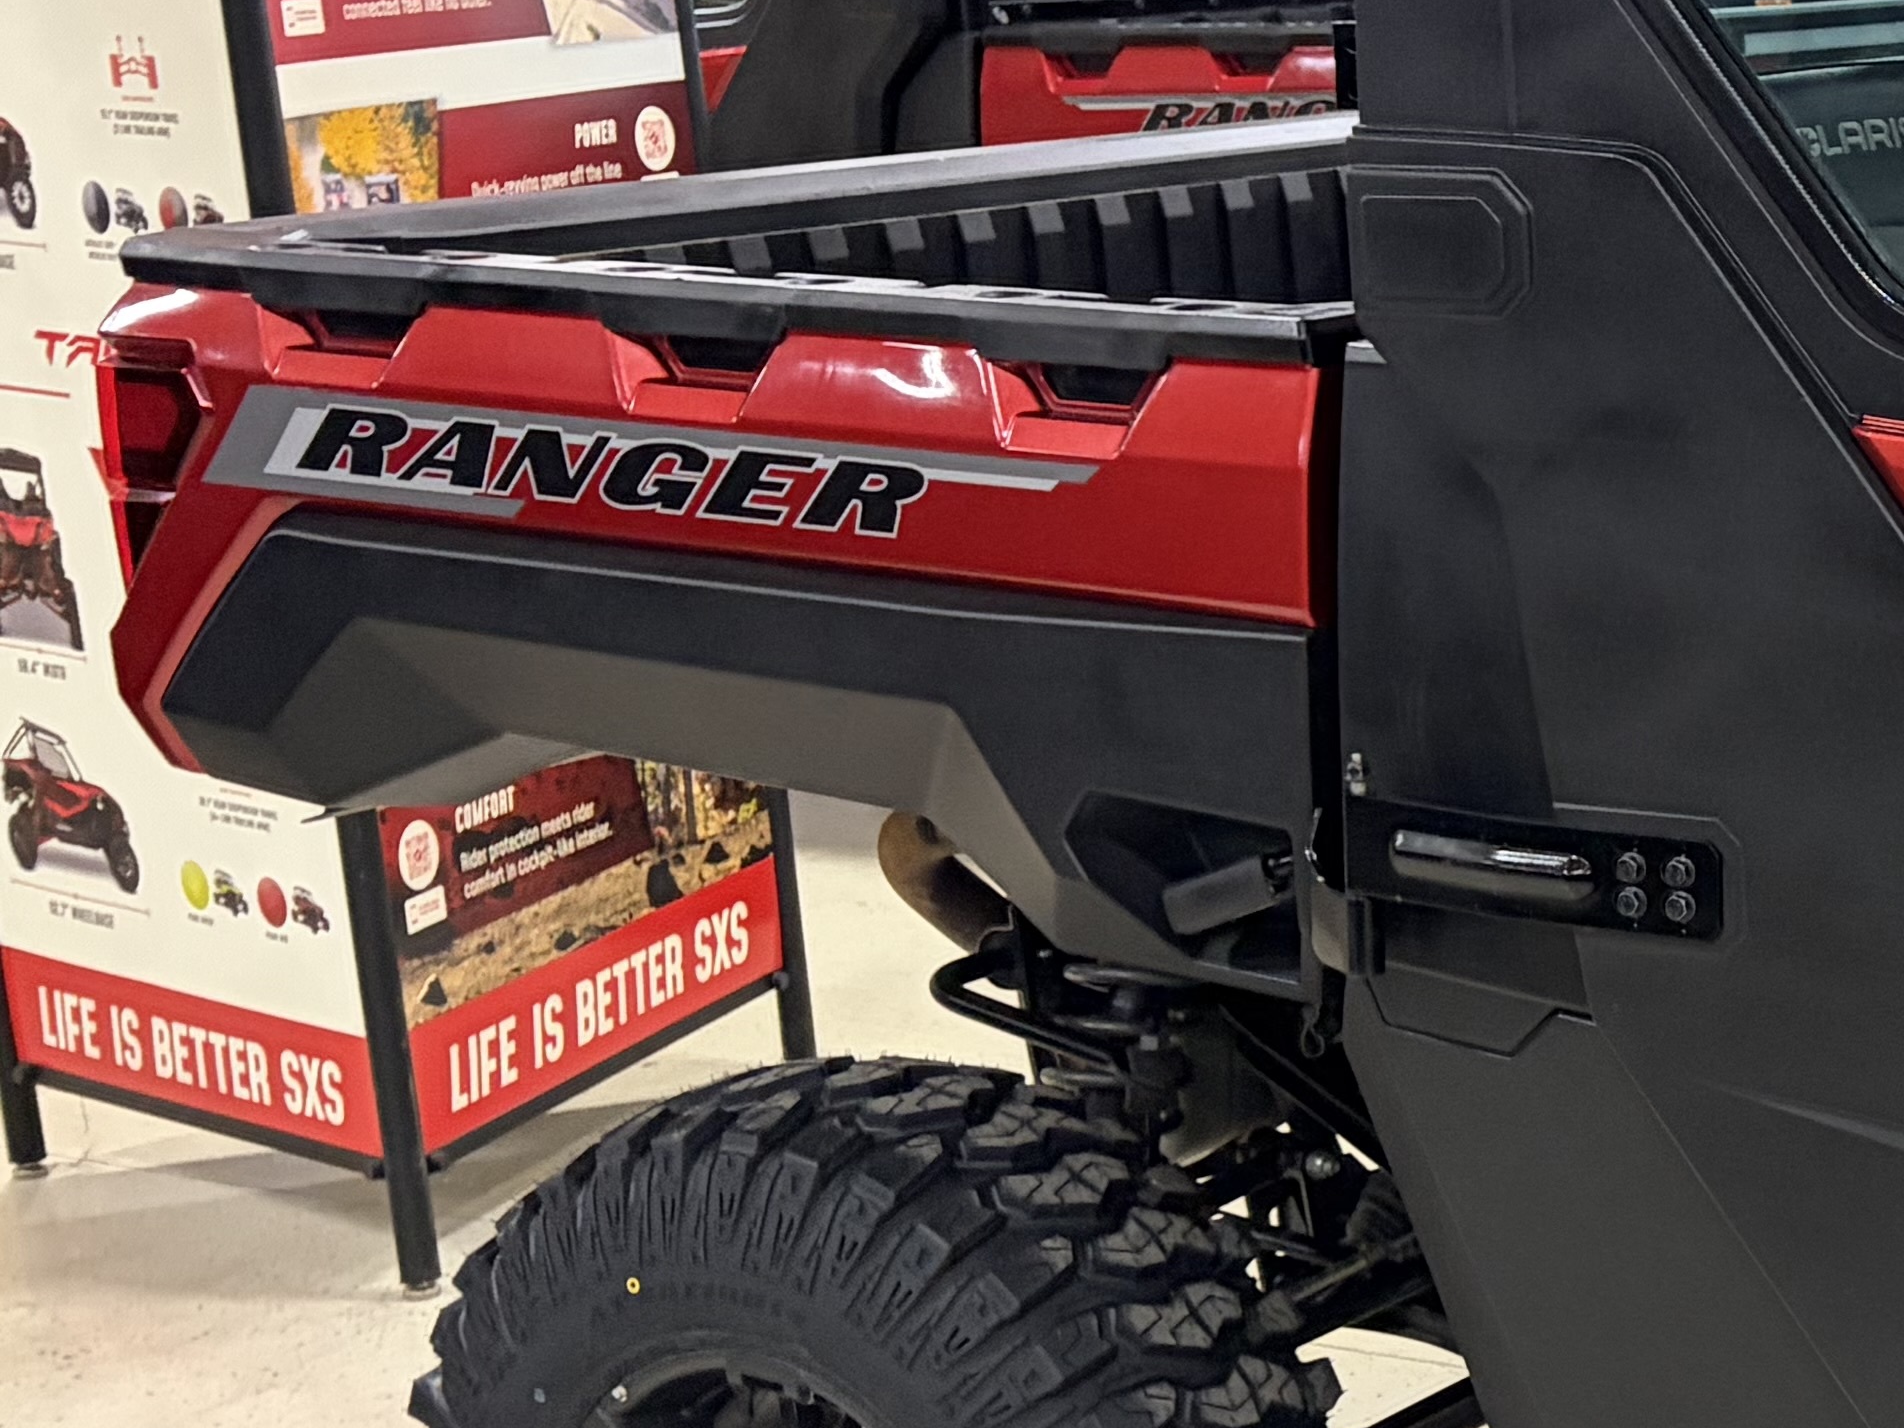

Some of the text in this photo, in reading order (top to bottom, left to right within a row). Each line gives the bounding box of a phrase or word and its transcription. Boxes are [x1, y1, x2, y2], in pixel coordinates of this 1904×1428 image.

[574, 119, 617, 149] POWER
[569, 164, 586, 185] off
[586, 162, 603, 183] the
[294, 402, 928, 538] RANGER
[454, 785, 516, 833] COMFORT
[460, 801, 596, 872] Rider protection meets rider
[464, 864, 506, 900] comfort
[506, 861, 518, 882] in
[518, 837, 576, 876] cockpit-like
[449, 900, 749, 1114] LIFE IS BETTER SXS
[38, 985, 345, 1127] LIFE IS BETTER SXS
